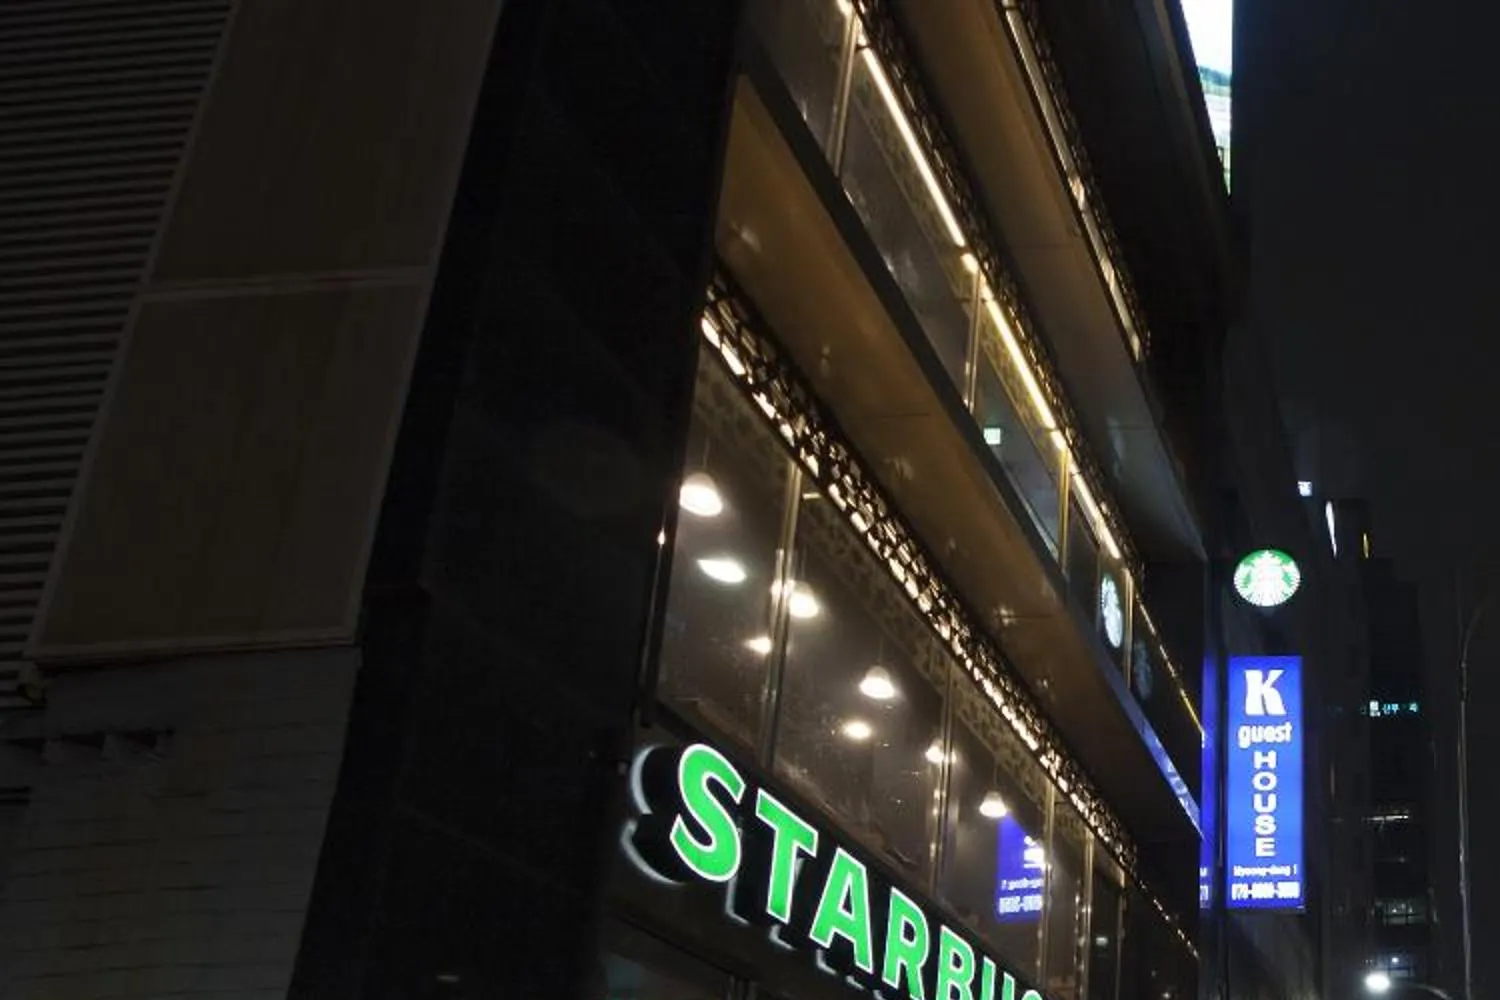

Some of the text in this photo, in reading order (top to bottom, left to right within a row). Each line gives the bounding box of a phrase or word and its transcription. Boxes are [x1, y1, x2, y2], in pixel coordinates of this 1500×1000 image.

[1244, 669, 1287, 716] K
[1237, 721, 1293, 749] guest
[1251, 750, 1278, 857] HOUSE
